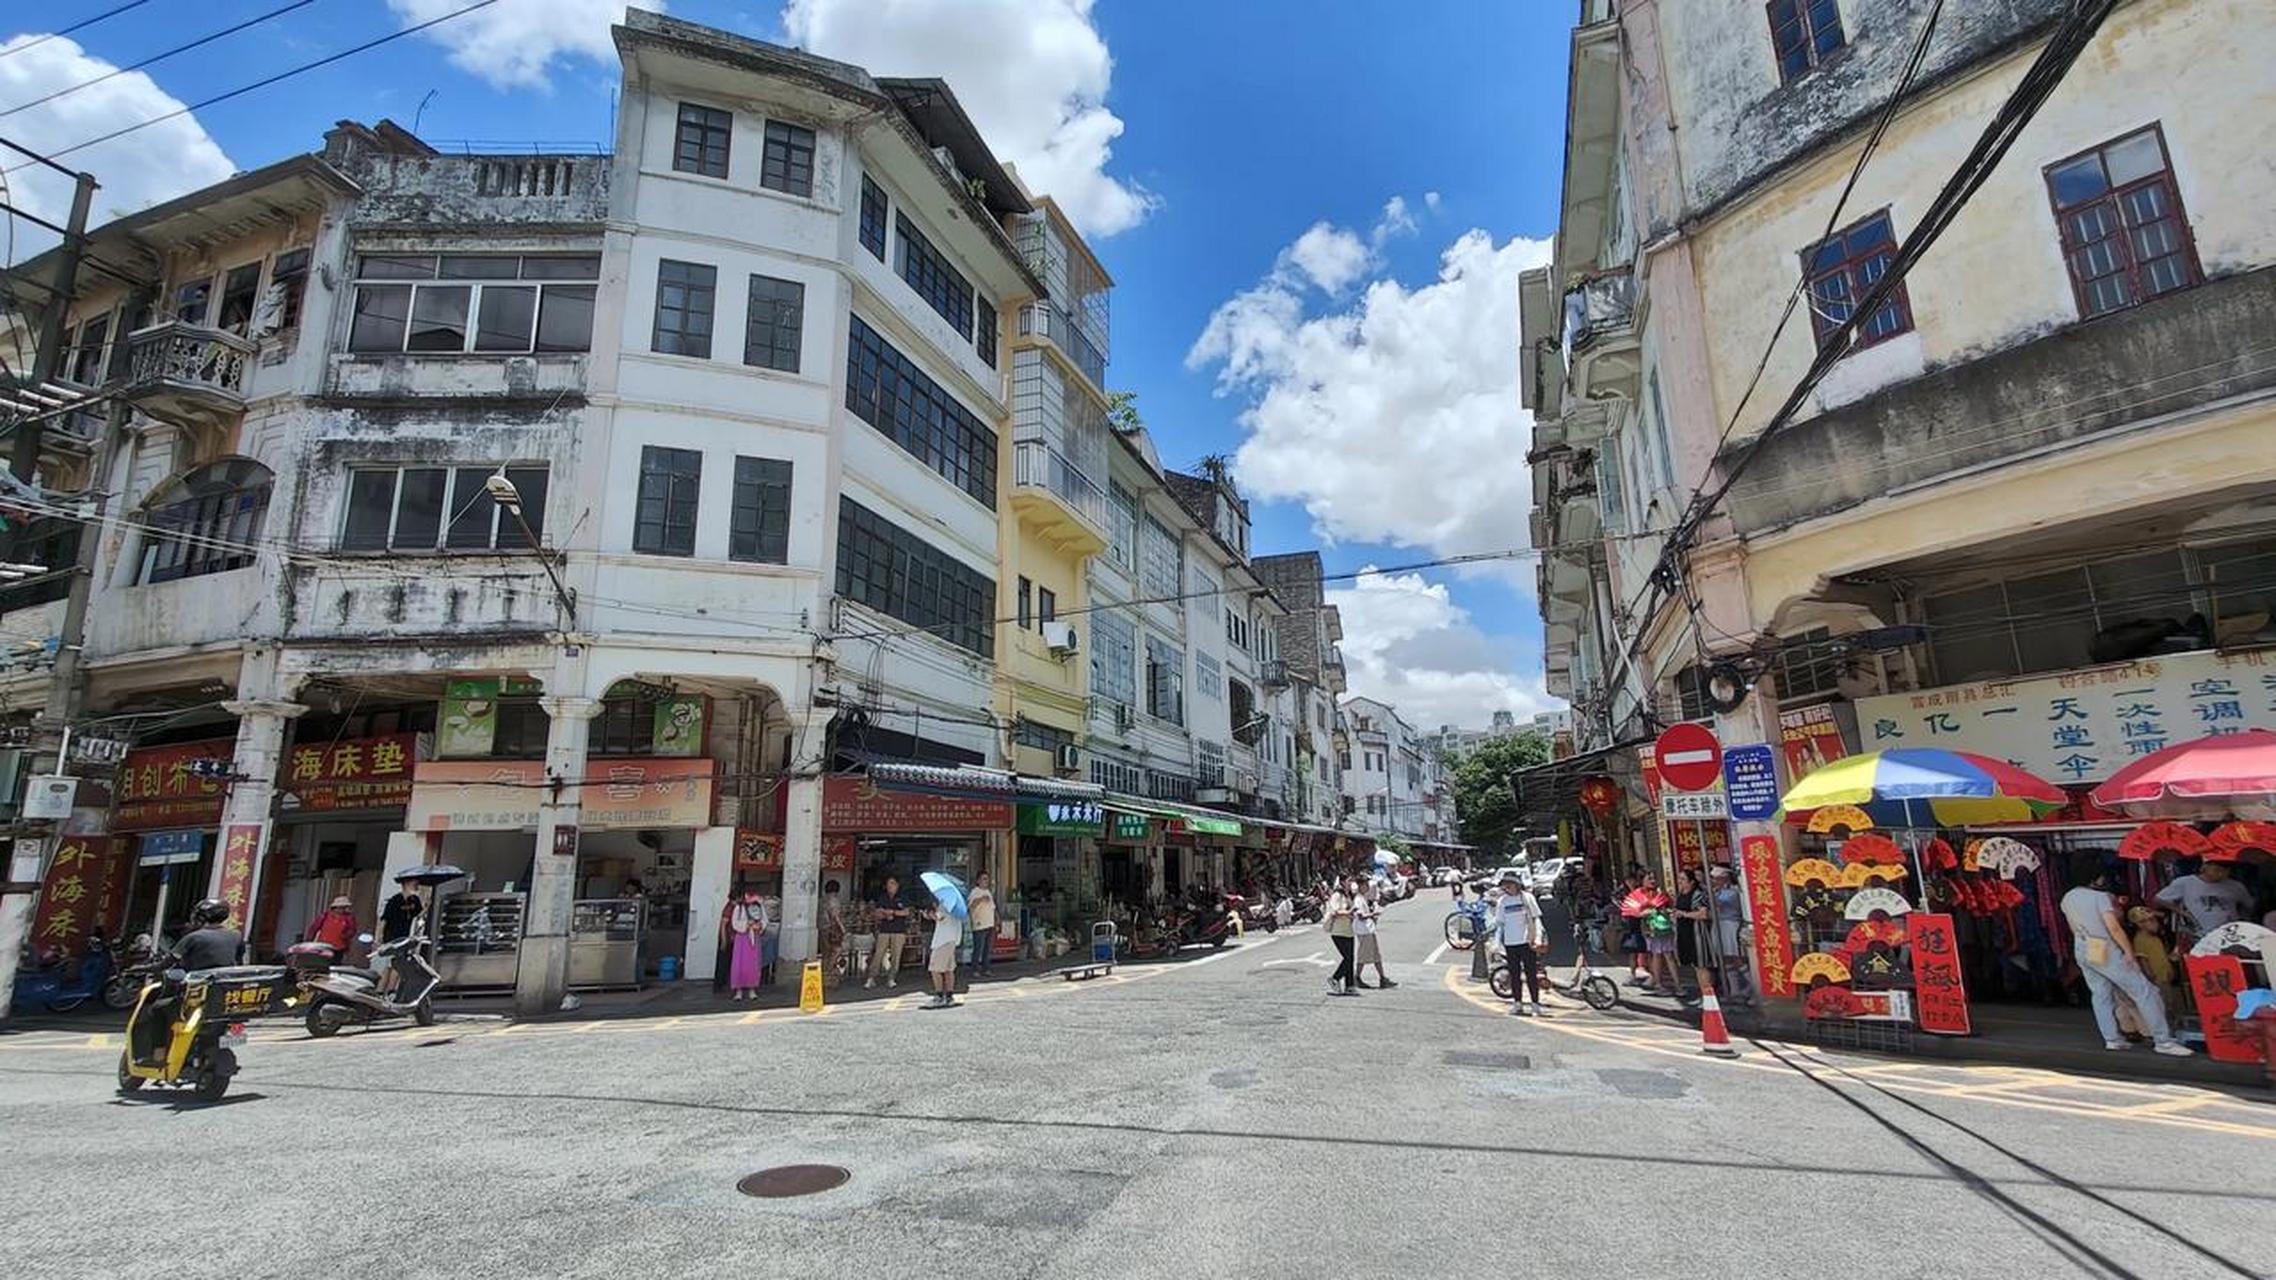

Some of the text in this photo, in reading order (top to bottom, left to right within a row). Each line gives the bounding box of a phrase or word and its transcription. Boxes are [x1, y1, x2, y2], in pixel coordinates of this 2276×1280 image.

[2048, 697, 2099, 778] 天堂伞
[292, 741, 405, 780] 海床垫
[1665, 796, 1724, 814] 摩托车除外
